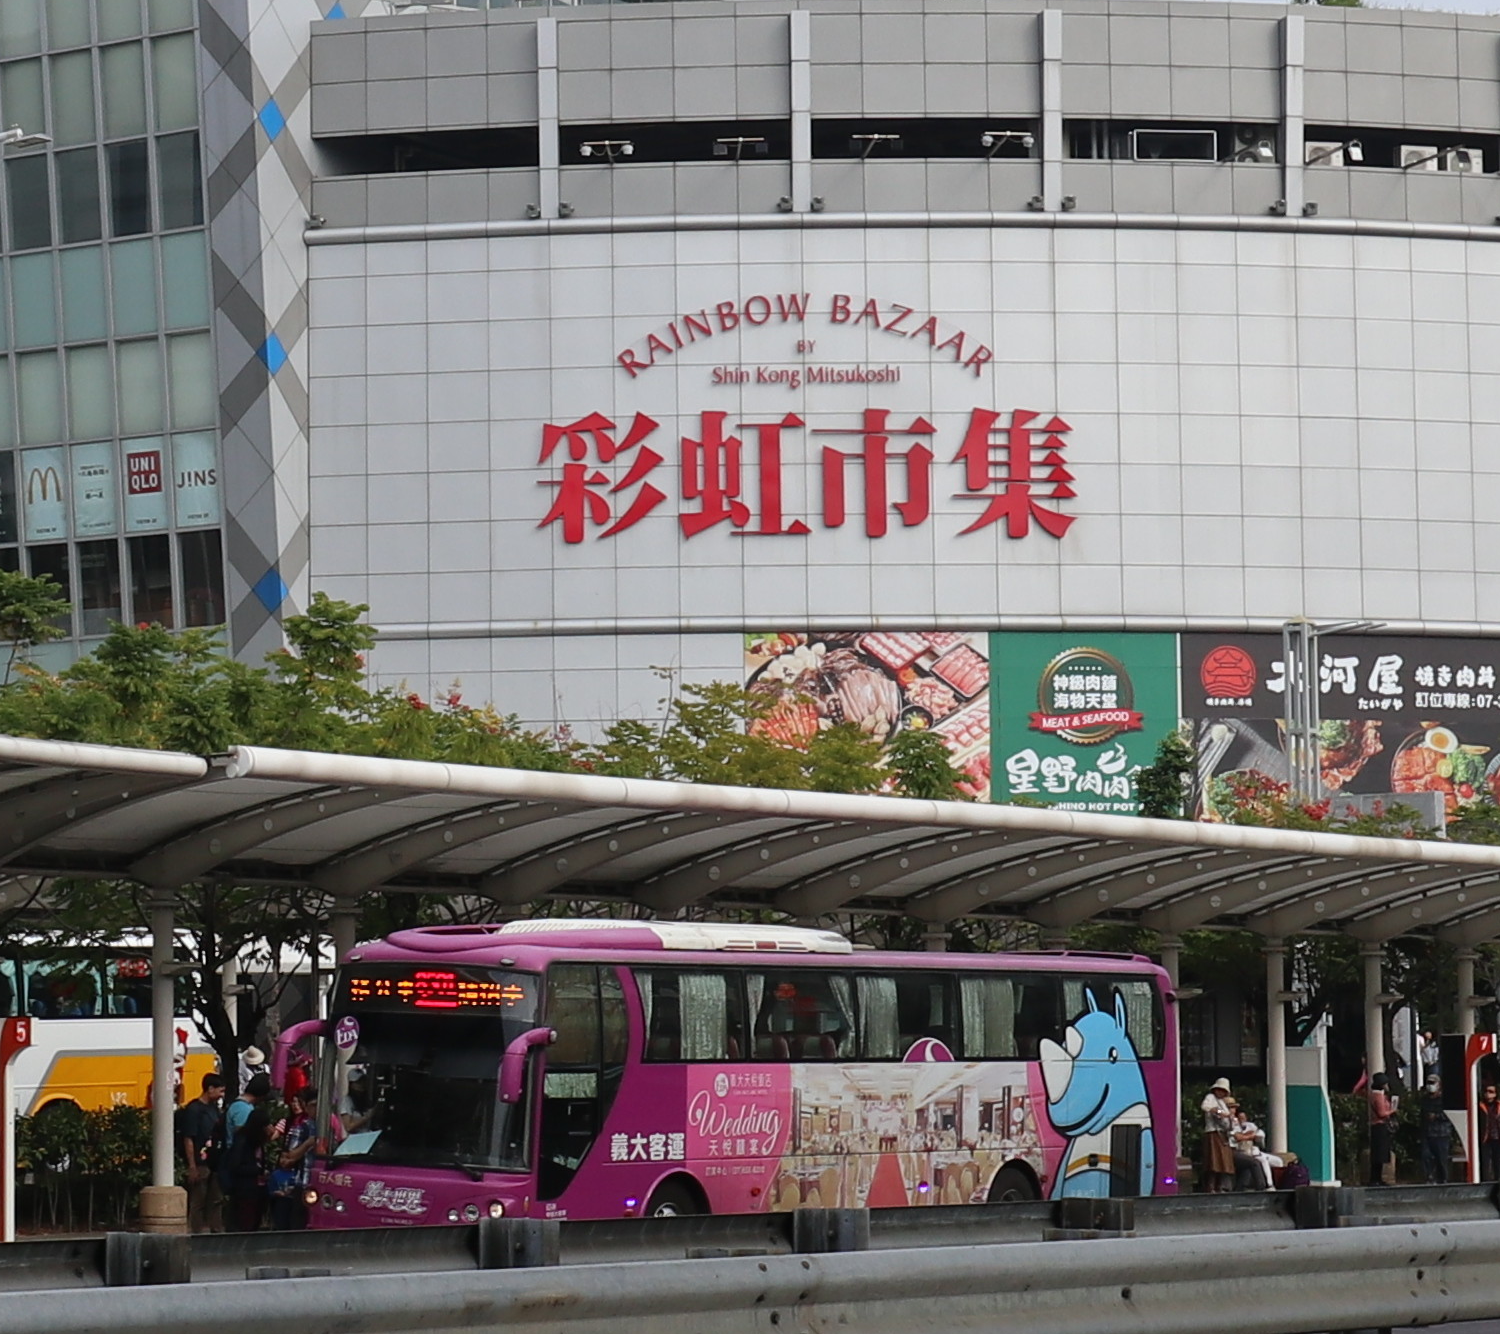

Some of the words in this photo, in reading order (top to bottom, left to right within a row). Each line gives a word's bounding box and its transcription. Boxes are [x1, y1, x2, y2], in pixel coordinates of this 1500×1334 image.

[617, 293, 810, 378] RAINBOW
[829, 294, 993, 378] BAZAAR
[798, 340, 816, 354] BY
[712, 366, 750, 384] Shin
[756, 367, 800, 388] Kong
[807, 365, 900, 384] Mitsukoshi
[130, 456, 156, 473] UNI
[131, 473, 158, 491] QLO
[536, 407, 1077, 544] 彩虹市集
[1053, 693, 1118, 709] 海物天堂
[1042, 717, 1070, 729] MEAT
[1072, 716, 1080, 727] &
[1082, 711, 1129, 725] SEAFOOD
[1006, 748, 1148, 799] 星野肉肉
[1088, 802, 1112, 811] HOT
[1113, 803, 1135, 812] POT
[16, 1021, 26, 1043] 5
[1480, 1035, 1489, 1050] 7
[689, 1090, 782, 1155] Wedding
[611, 1133, 685, 1161] 義大客運
